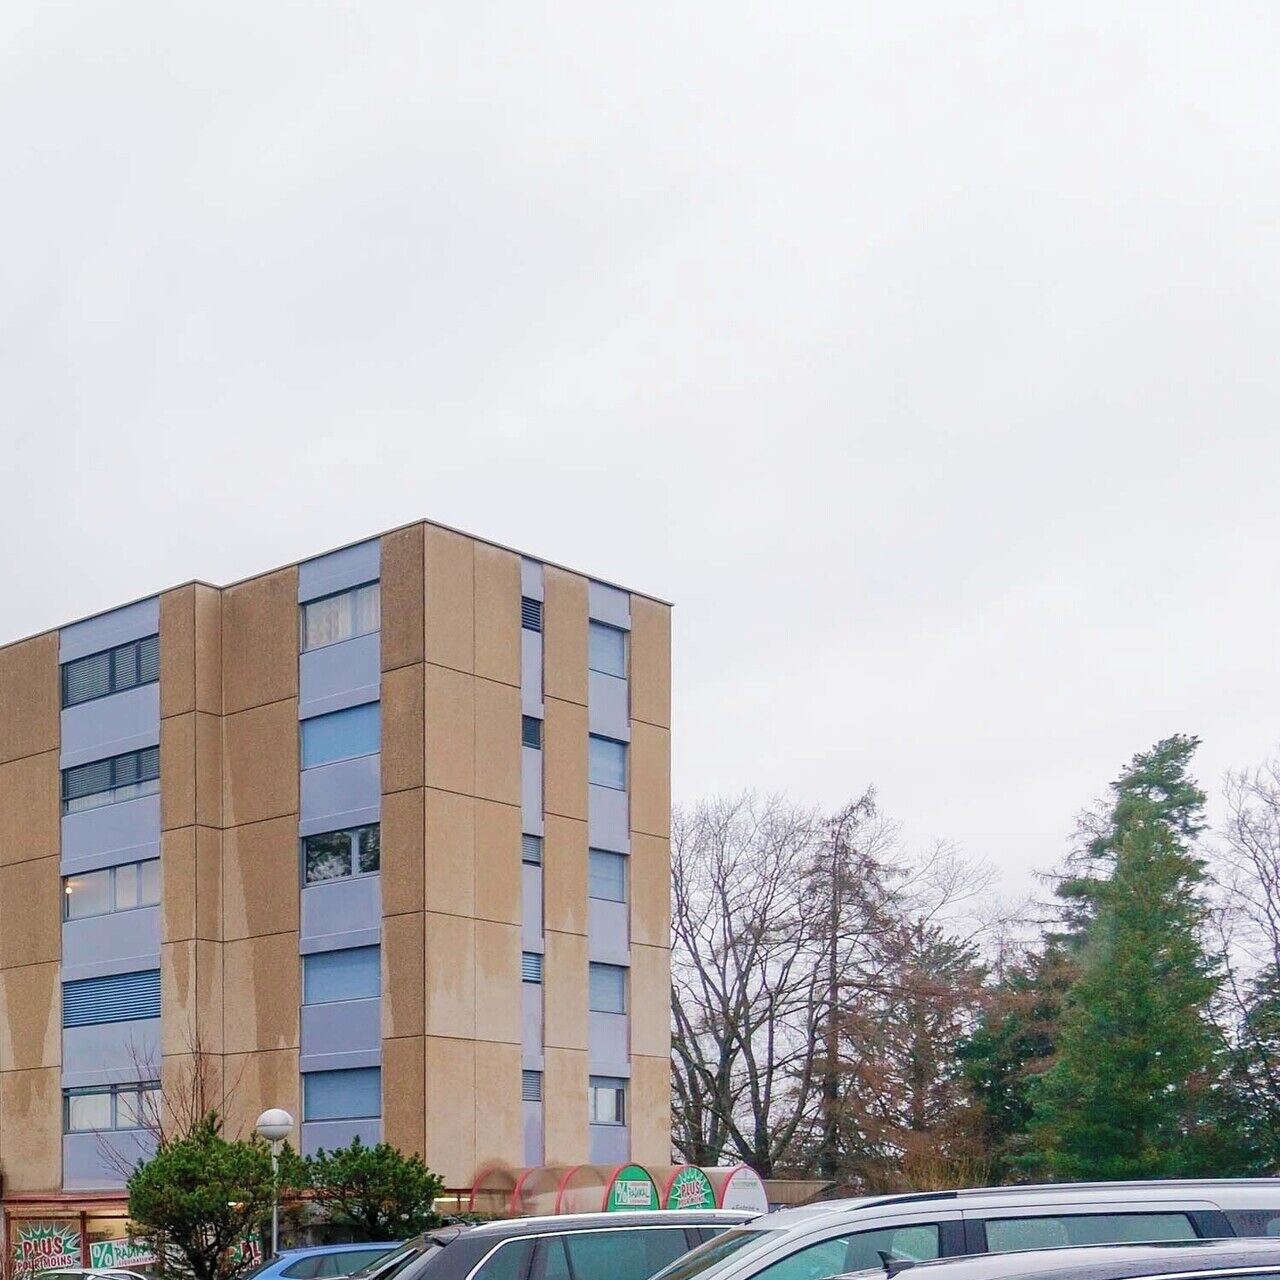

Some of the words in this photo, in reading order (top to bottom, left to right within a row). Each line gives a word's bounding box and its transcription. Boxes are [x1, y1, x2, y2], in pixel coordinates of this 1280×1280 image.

[681, 1181, 701, 1196] PLUS
[23, 1236, 63, 1258] PLUS
[17, 1258, 41, 1271] POUR
[43, 1255, 72, 1268] MOINS
